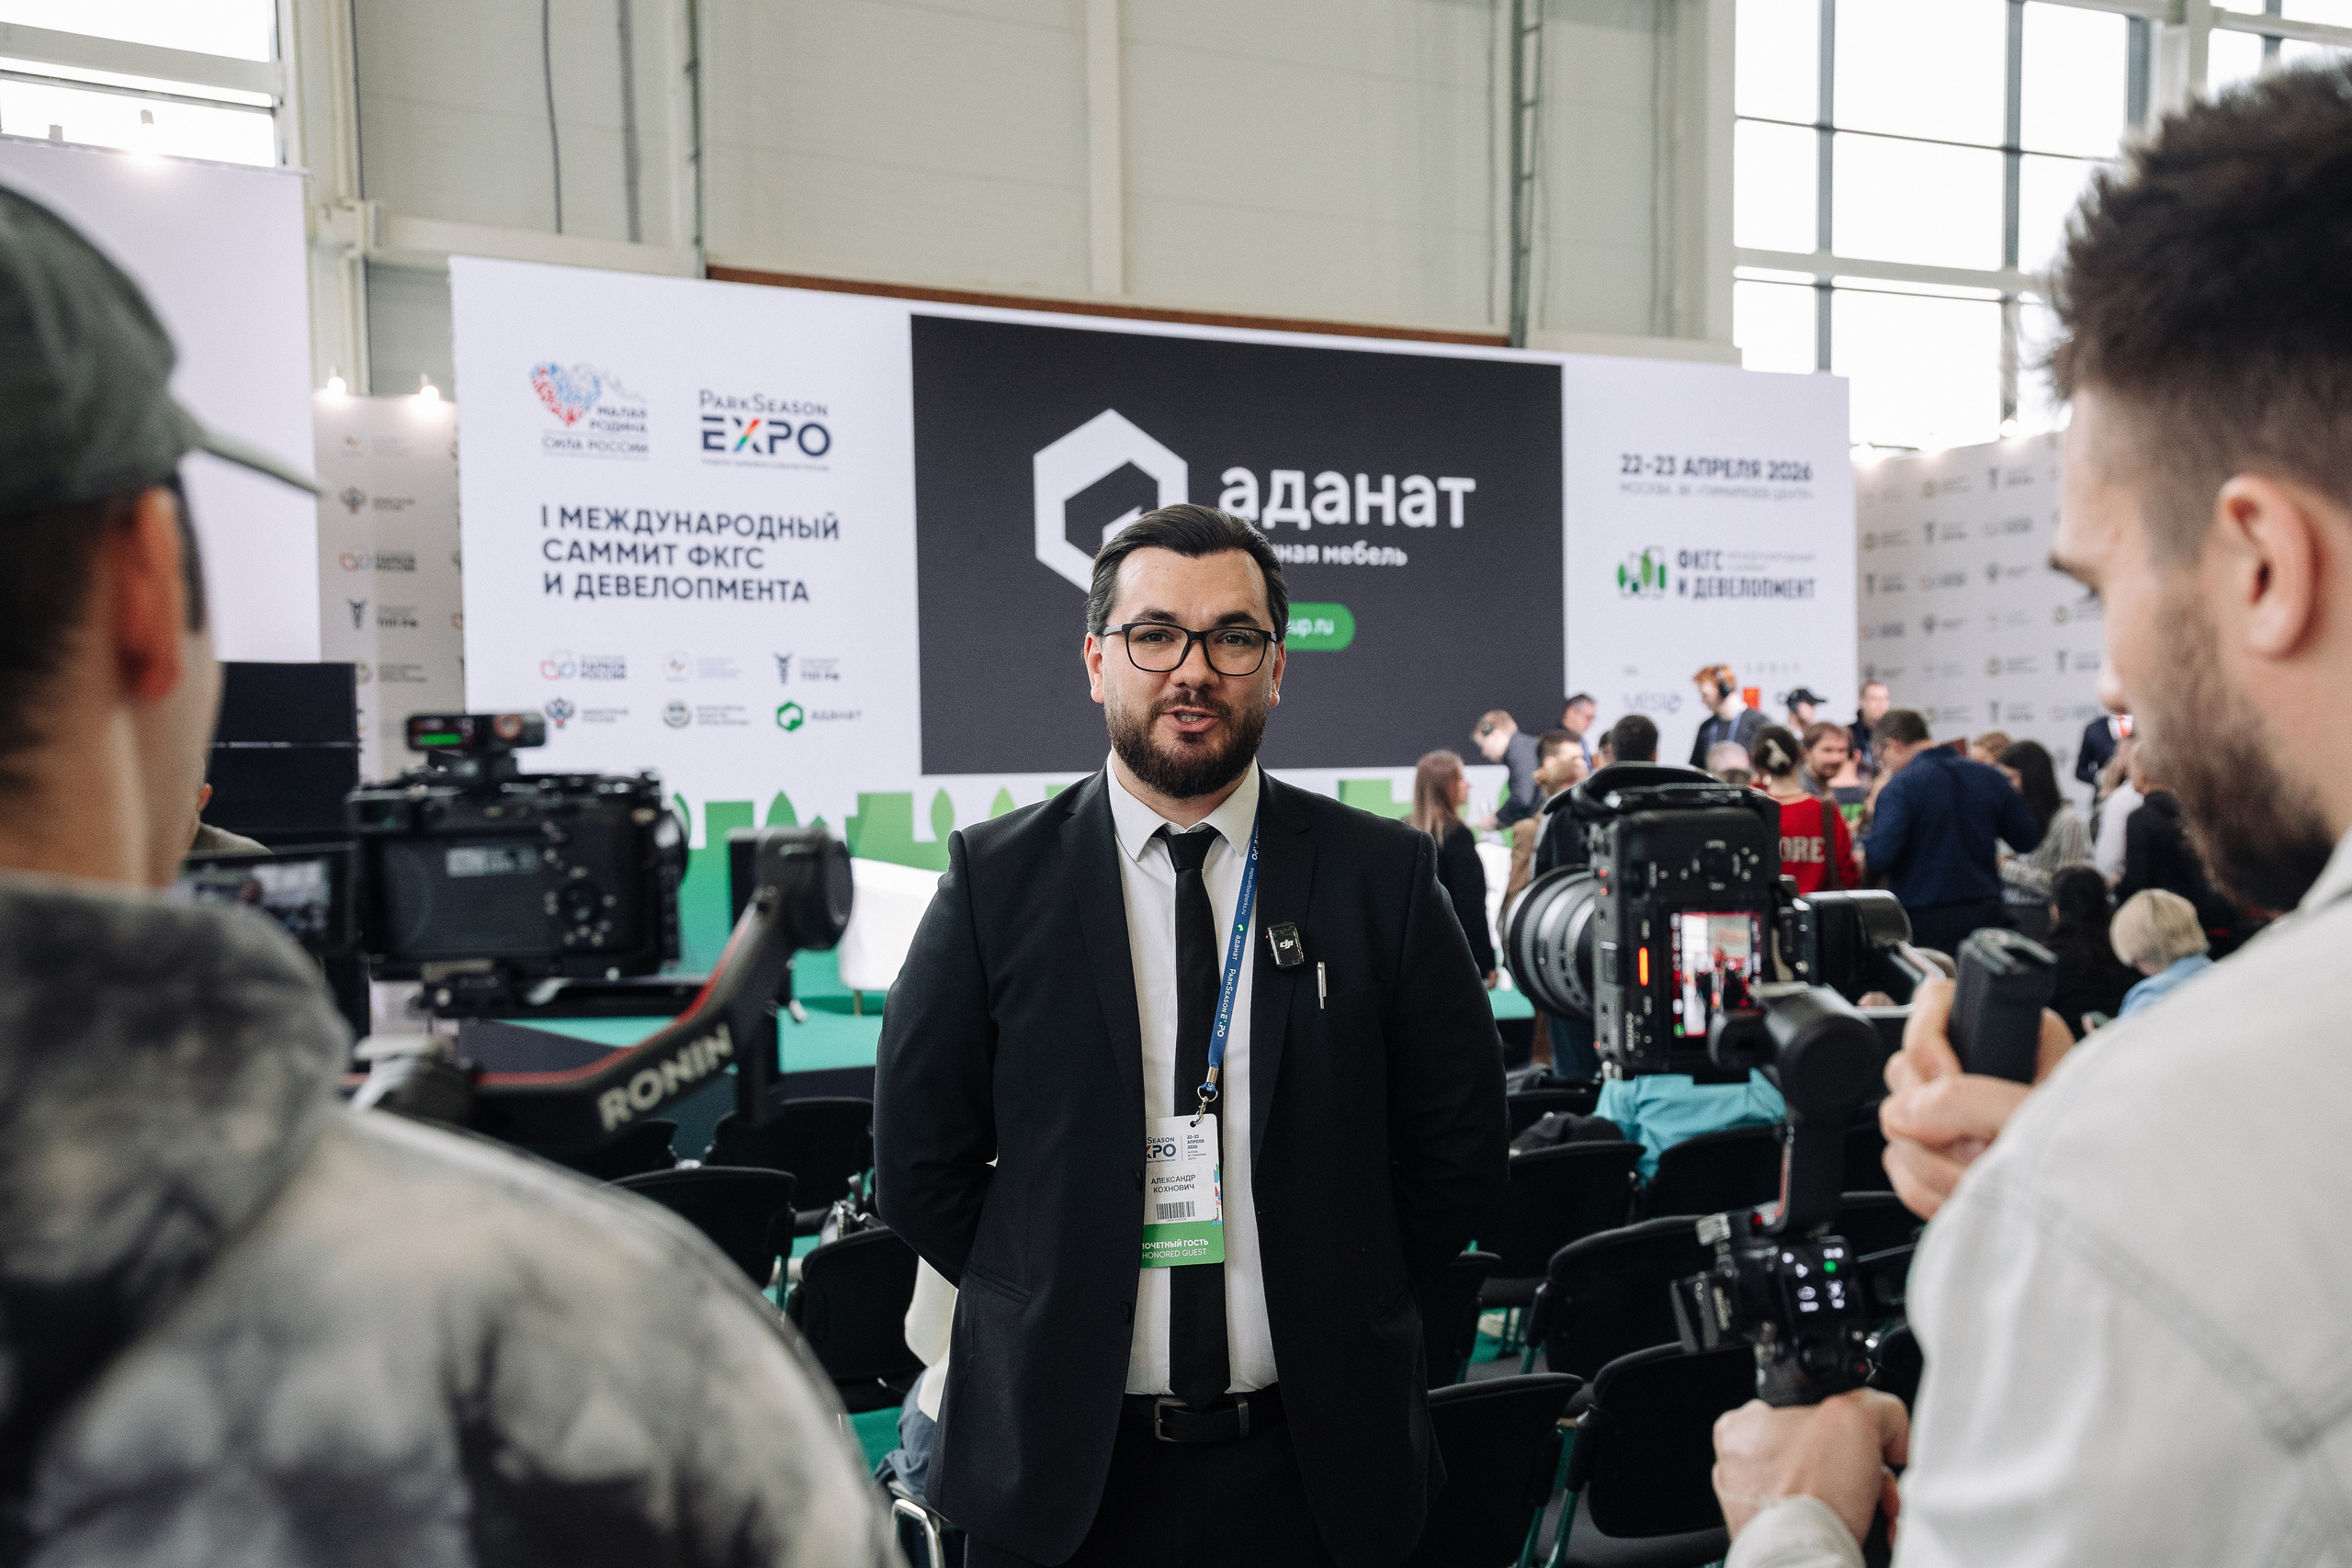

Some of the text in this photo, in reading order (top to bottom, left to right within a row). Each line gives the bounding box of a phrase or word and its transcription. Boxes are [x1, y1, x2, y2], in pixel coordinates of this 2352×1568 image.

[701, 415, 831, 457] EXPO
[1621, 453, 1675, 476] 22-23
[1683, 457, 1760, 480] АПРЕЛЯ
[1219, 466, 1476, 531] аданат
[560, 506, 839, 541] МЕЖДУНАРОДНЫЙ
[543, 538, 764, 570] САММИТ ФКГС
[1322, 539, 1408, 566] мебель
[544, 571, 809, 603] И ДЕВЕЛОПМЕНТА
[1231, 935, 1241, 961] аданат
[598, 1022, 734, 1133] RONIN
[1146, 1144, 1177, 1158] XPO
[1147, 1136, 1175, 1145] SEASON
[1151, 1175, 1196, 1185] АЛЕКСАНДР
[1153, 1184, 1195, 1193] КОХНОВИЧ
[1142, 1248, 1207, 1259] HONORED GUEST
[1183, 1238, 1209, 1247] ГОСТЬ
